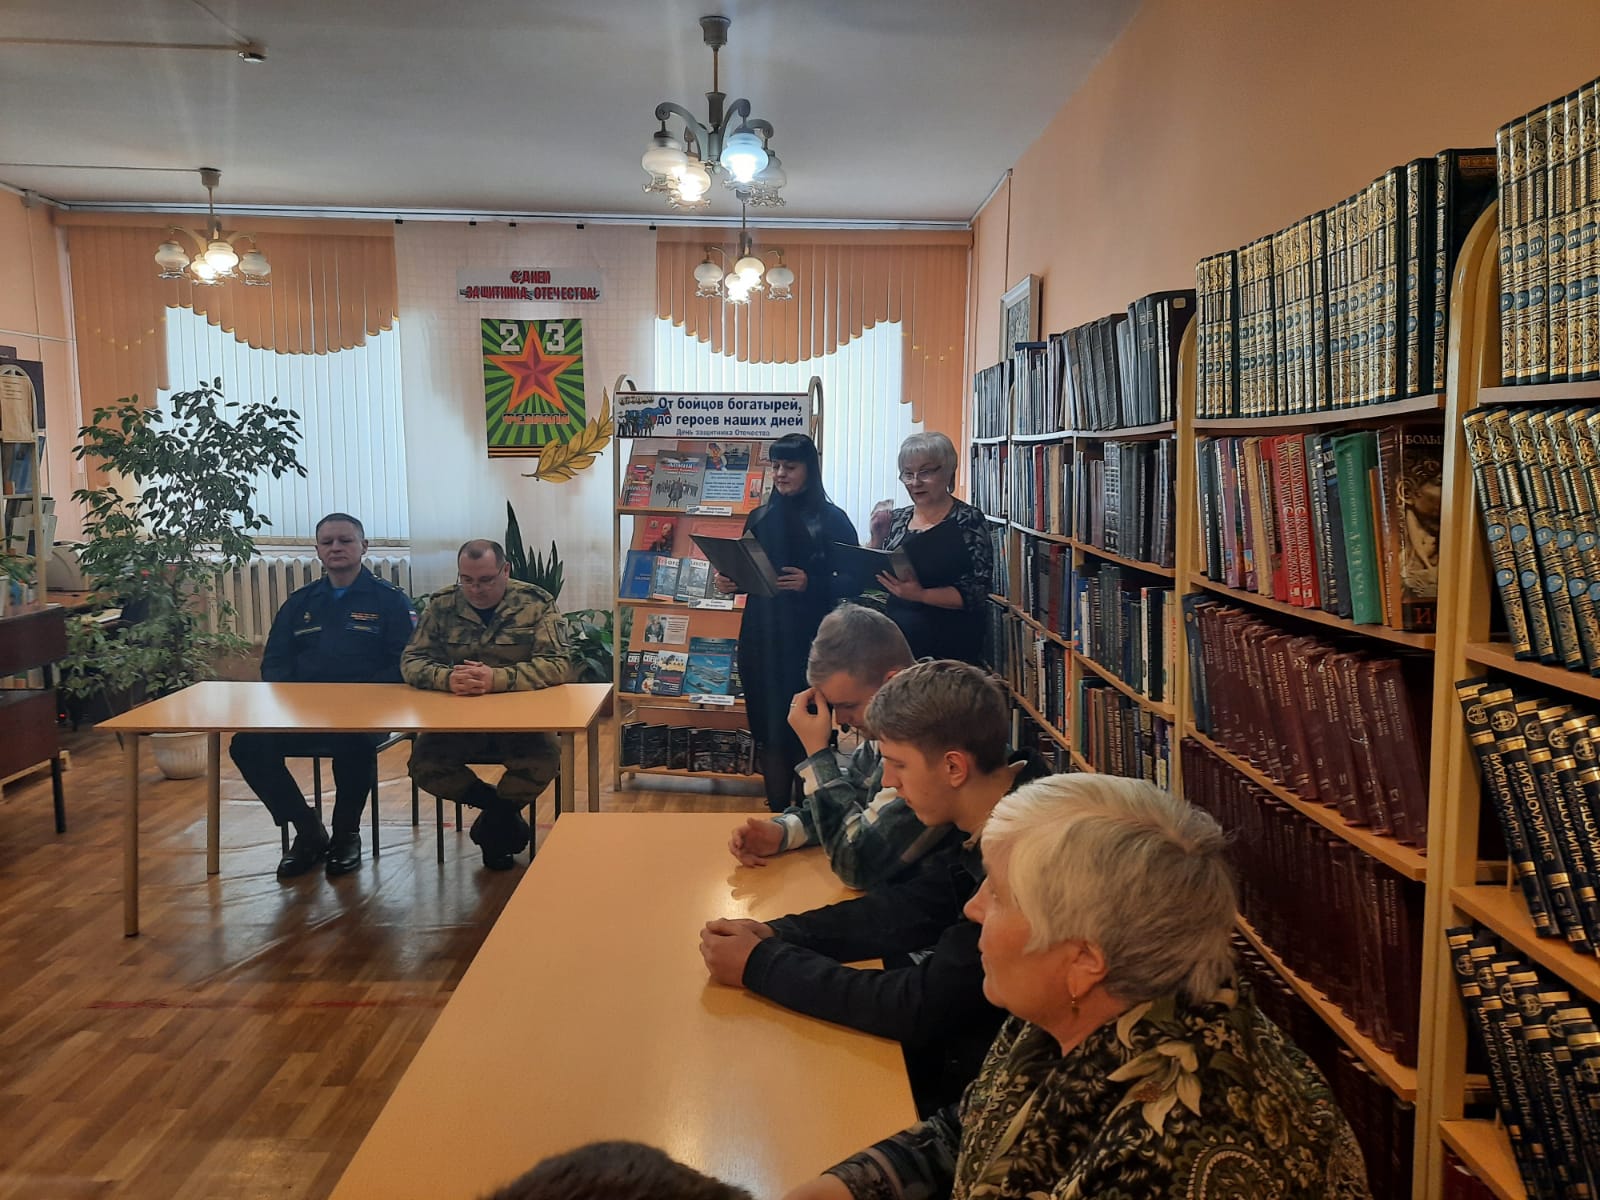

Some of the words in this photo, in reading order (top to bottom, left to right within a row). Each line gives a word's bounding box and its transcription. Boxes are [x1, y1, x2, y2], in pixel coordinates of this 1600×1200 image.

[466, 285, 527, 300] ЗАЩИТНИКА
[658, 397, 674, 410] От
[677, 397, 724, 412] бойцов
[727, 398, 803, 414] богатырей,
[657, 415, 672, 427] до
[676, 416, 719, 427] героев
[723, 416, 767, 427] наших
[770, 414, 803, 428] дней
[676, 428, 694, 437] День
[695, 429, 734, 437] защитника
[1489, 752, 1524, 850] ЭНЦИКЛОПЕДИЯ
[1515, 760, 1556, 862] ЭНЦИКЛОПЕДИЯ
